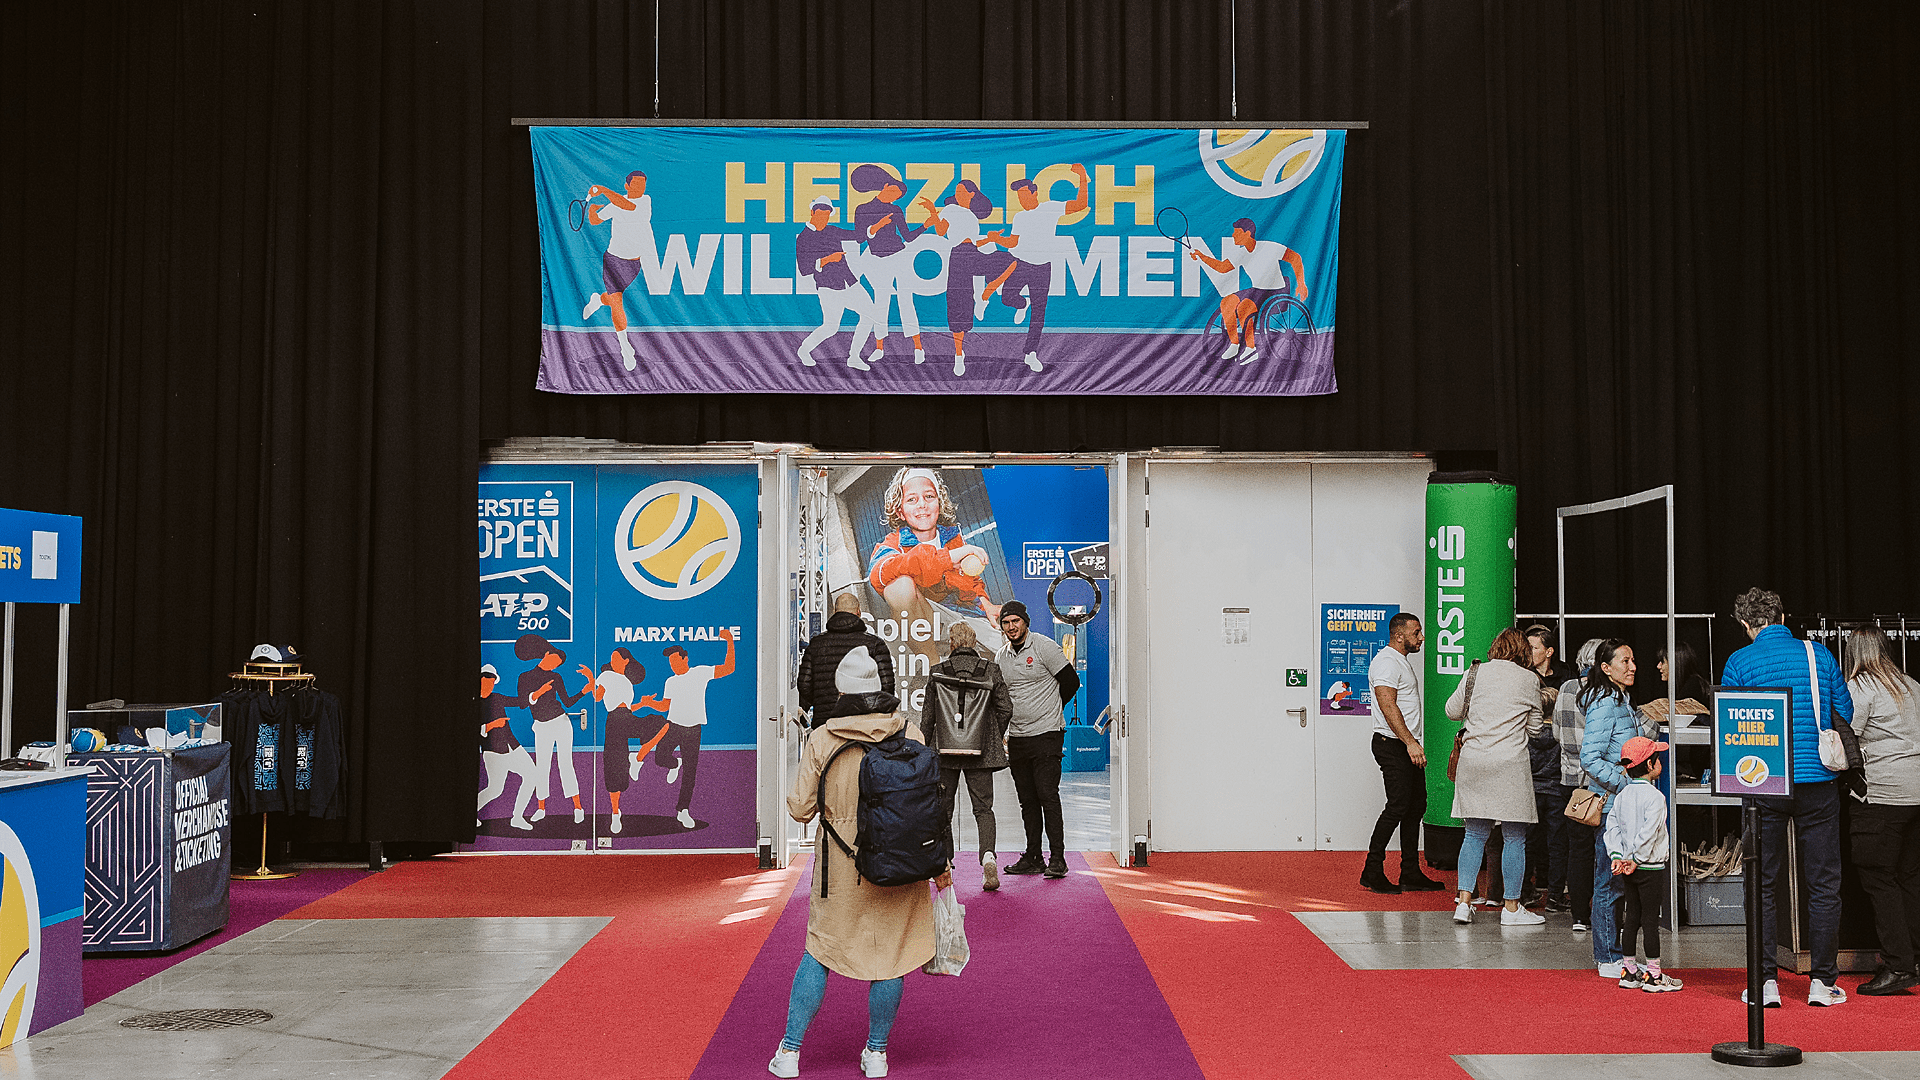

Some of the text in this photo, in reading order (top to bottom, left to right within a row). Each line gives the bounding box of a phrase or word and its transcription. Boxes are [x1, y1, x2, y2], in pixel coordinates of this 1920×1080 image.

[641, 233, 1240, 297] WILKOMEN
[478, 519, 559, 559] OPEN
[1027, 549, 1055, 558] ERSTE
[1078, 555, 1106, 566] ATP
[1027, 558, 1065, 576] OPEN
[480, 592, 549, 618] ATP
[1326, 609, 1387, 621] SICHERHEIT
[1436, 566, 1465, 675] ERSTE
[517, 617, 550, 631] 500
[1327, 620, 1377, 632] GEHT VOR
[614, 626, 676, 643] MARX
[1727, 707, 1775, 721] TICKETS
[1737, 721, 1766, 733] HIER
[1724, 733, 1780, 747] SCANNEN
[175, 775, 210, 810] OFFICIAL
